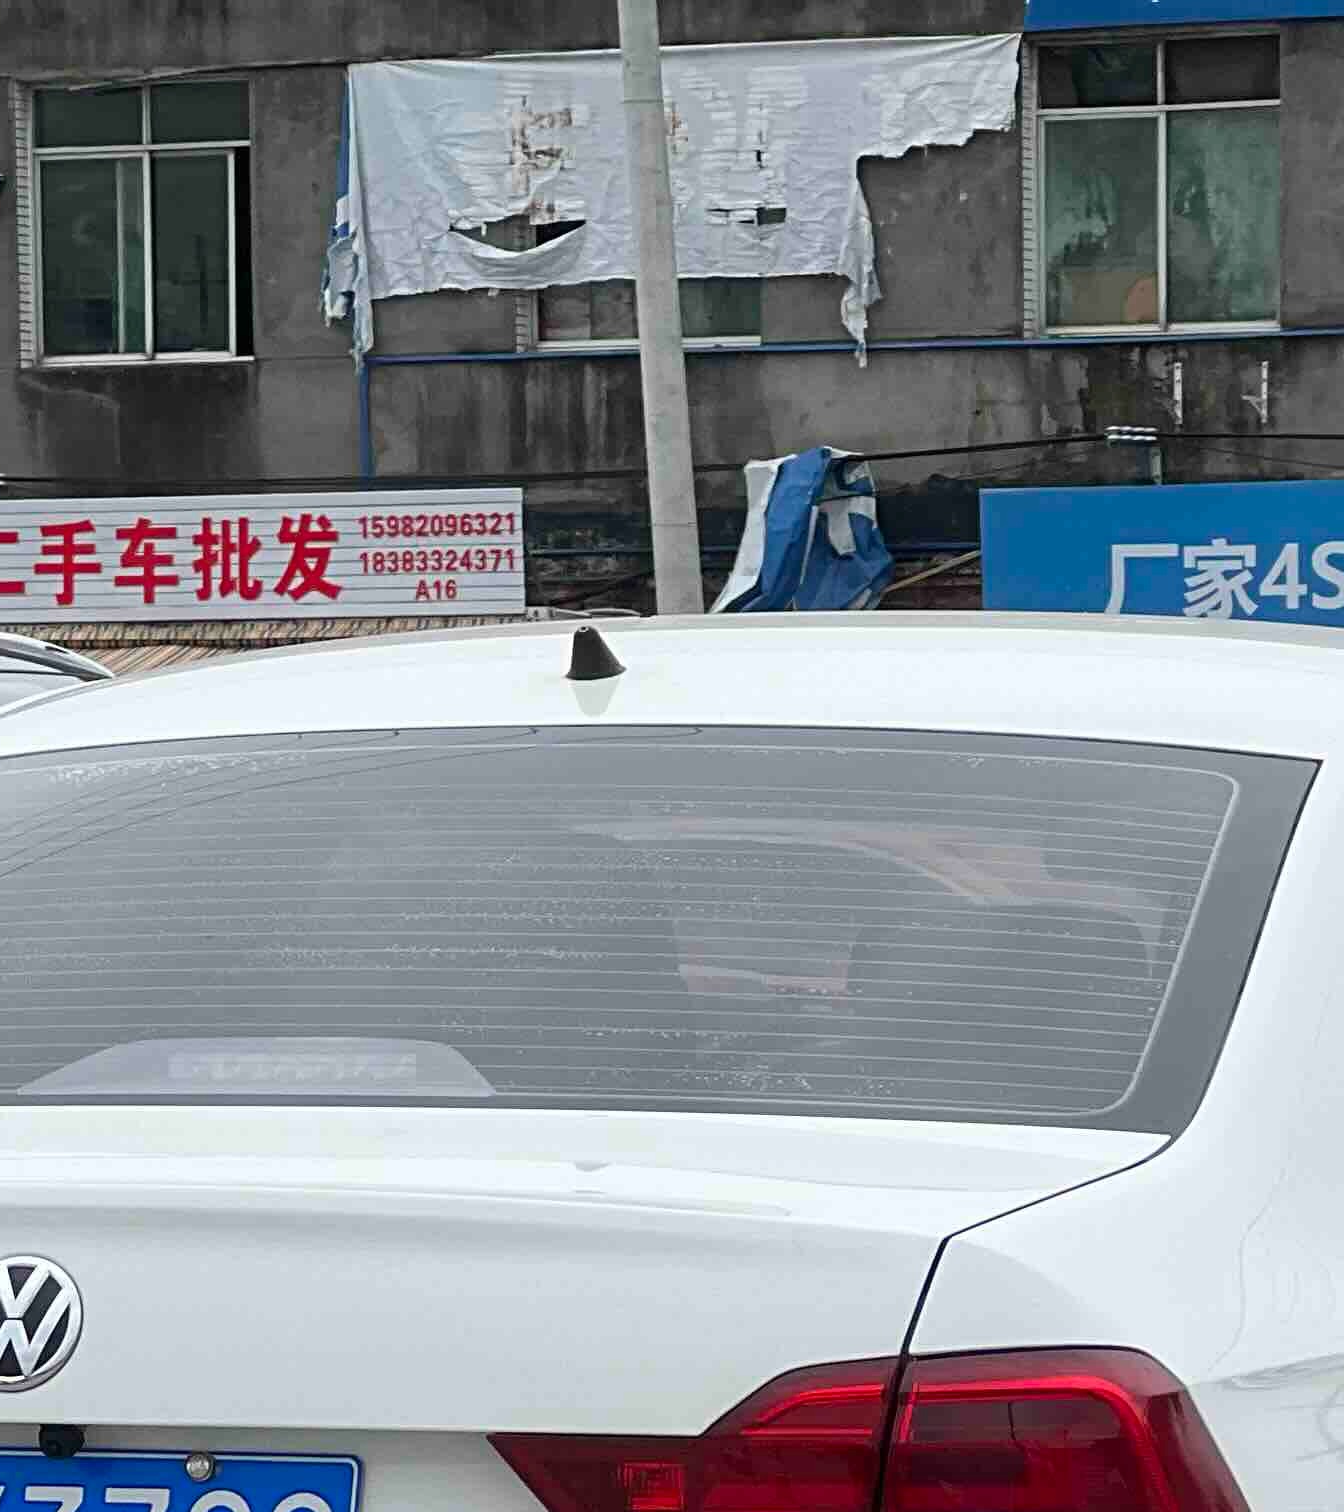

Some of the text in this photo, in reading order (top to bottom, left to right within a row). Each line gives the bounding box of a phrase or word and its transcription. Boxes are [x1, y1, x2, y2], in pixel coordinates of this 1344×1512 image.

[359, 512, 515, 539] 15982096321
[359, 548, 515, 574] 18383324371
[415, 580, 457, 600] A16
